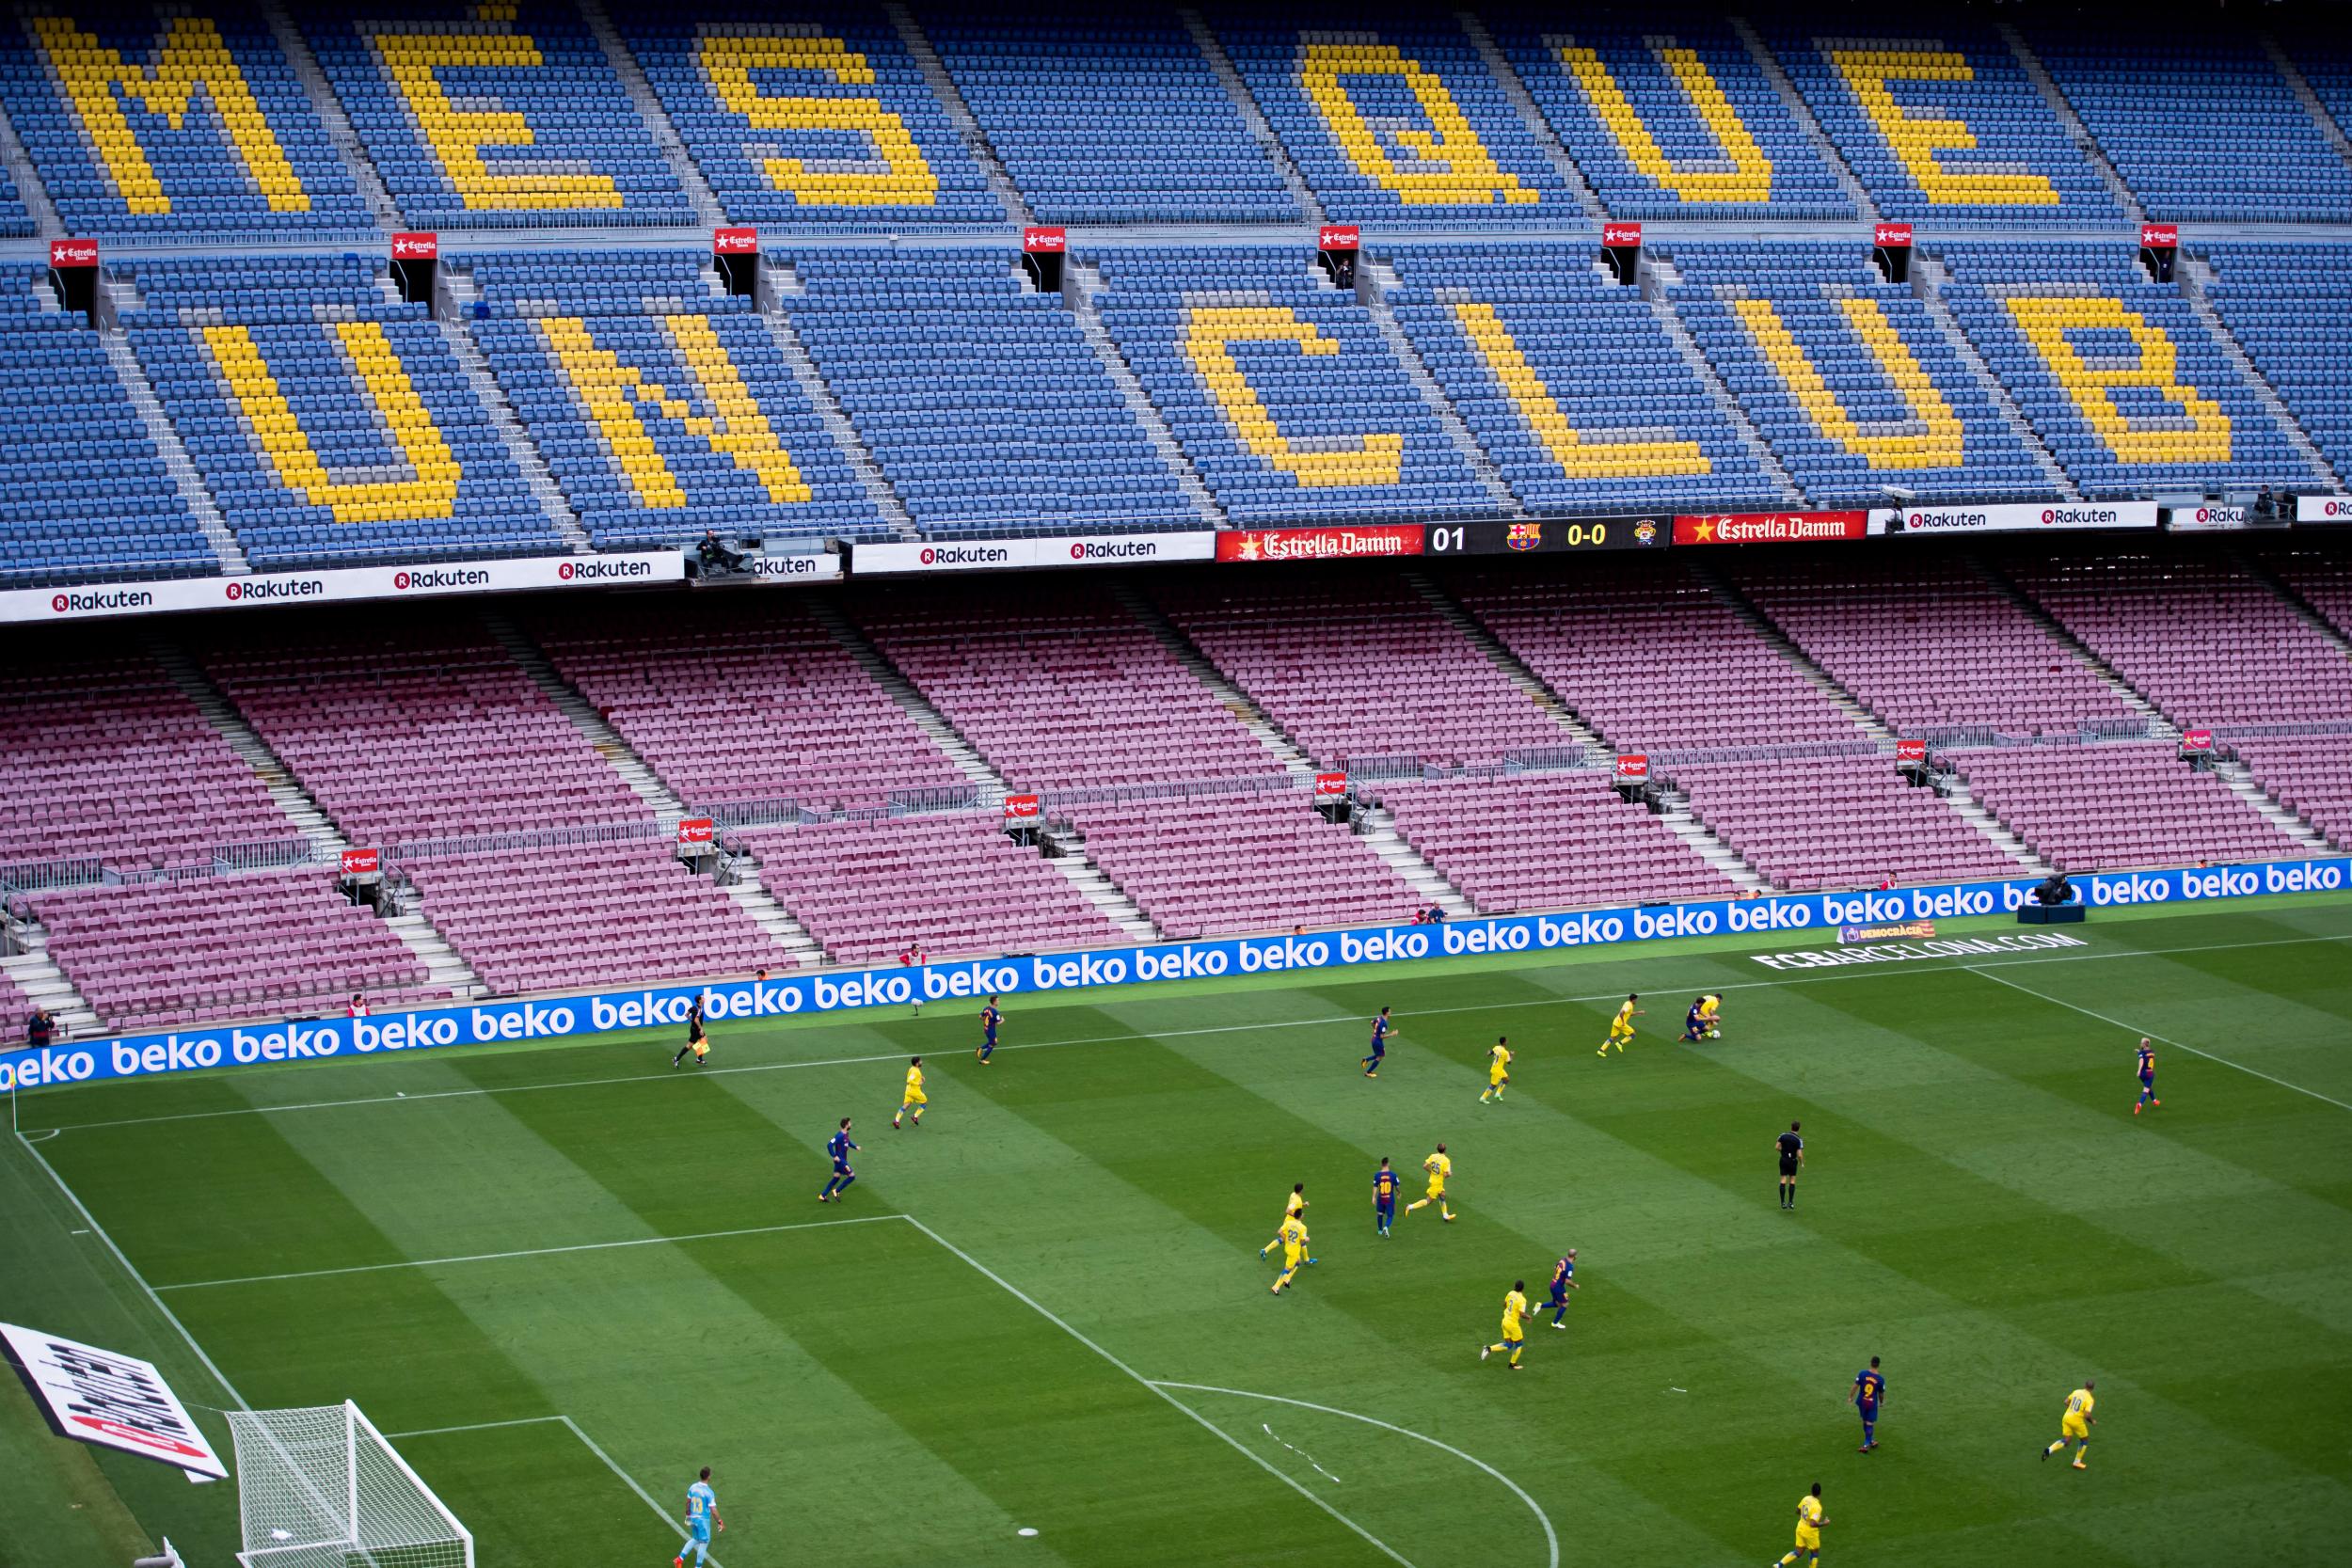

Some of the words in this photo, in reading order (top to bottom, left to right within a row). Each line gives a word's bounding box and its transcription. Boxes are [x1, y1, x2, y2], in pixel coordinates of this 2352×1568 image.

[34, 1, 939, 214] MÉS
[1302, 44, 2060, 204] QUE
[68, 248, 96, 257] Estrella
[204, 316, 812, 523] UN
[1187, 298, 2232, 486] CLUB
[1923, 512, 1986, 528] Rakuten
[2055, 508, 2117, 524] Rakuten
[2208, 508, 2244, 523] Raku
[1432, 527, 1464, 551] 01
[1567, 523, 1606, 546] 0-0
[1717, 517, 1787, 541] Estrella
[1788, 517, 1846, 538] Damm
[935, 546, 1008, 563] Rakuten
[1086, 541, 1156, 558] Rakuten
[1263, 532, 1338, 556] Estrella
[1340, 531, 1402, 554] Damm
[754, 557, 816, 575] akuten
[70, 591, 152, 611] Rakuten
[243, 579, 323, 599] Rakuten
[411, 568, 489, 589] Rakuten
[575, 561, 651, 579] Rakuten
[1749, 932, 2089, 970] FCBARCELONA.COM
[111, 1035, 222, 1075] beko
[232, 1024, 341, 1063] beko
[353, 1013, 458, 1053] beko
[471, 1003, 575, 1041] beko
[592, 991, 693, 1030] beko
[700, 982, 803, 1020] beko
[814, 972, 912, 1009] beko
[923, 962, 1019, 999] beko
[1033, 953, 1127, 989] beko
[1136, 945, 1229, 981] beko
[1239, 936, 1329, 973] beko
[1341, 928, 1429, 963] beko
[1443, 921, 1531, 955] beko
[1538, 913, 1624, 947] beko
[1633, 906, 1718, 939] beko
[1727, 898, 1811, 932] beko
[1822, 893, 1905, 925] beko
[1913, 886, 1994, 919] beko
[2092, 874, 2170, 906] beko
[2182, 867, 2259, 899] beko
[2266, 862, 2342, 893] beko
[1379, 1181, 1391, 1195] 10
[1287, 1229, 1298, 1243] 22
[1864, 1383, 1874, 1397] 9
[2070, 1396, 2082, 1413] 10
